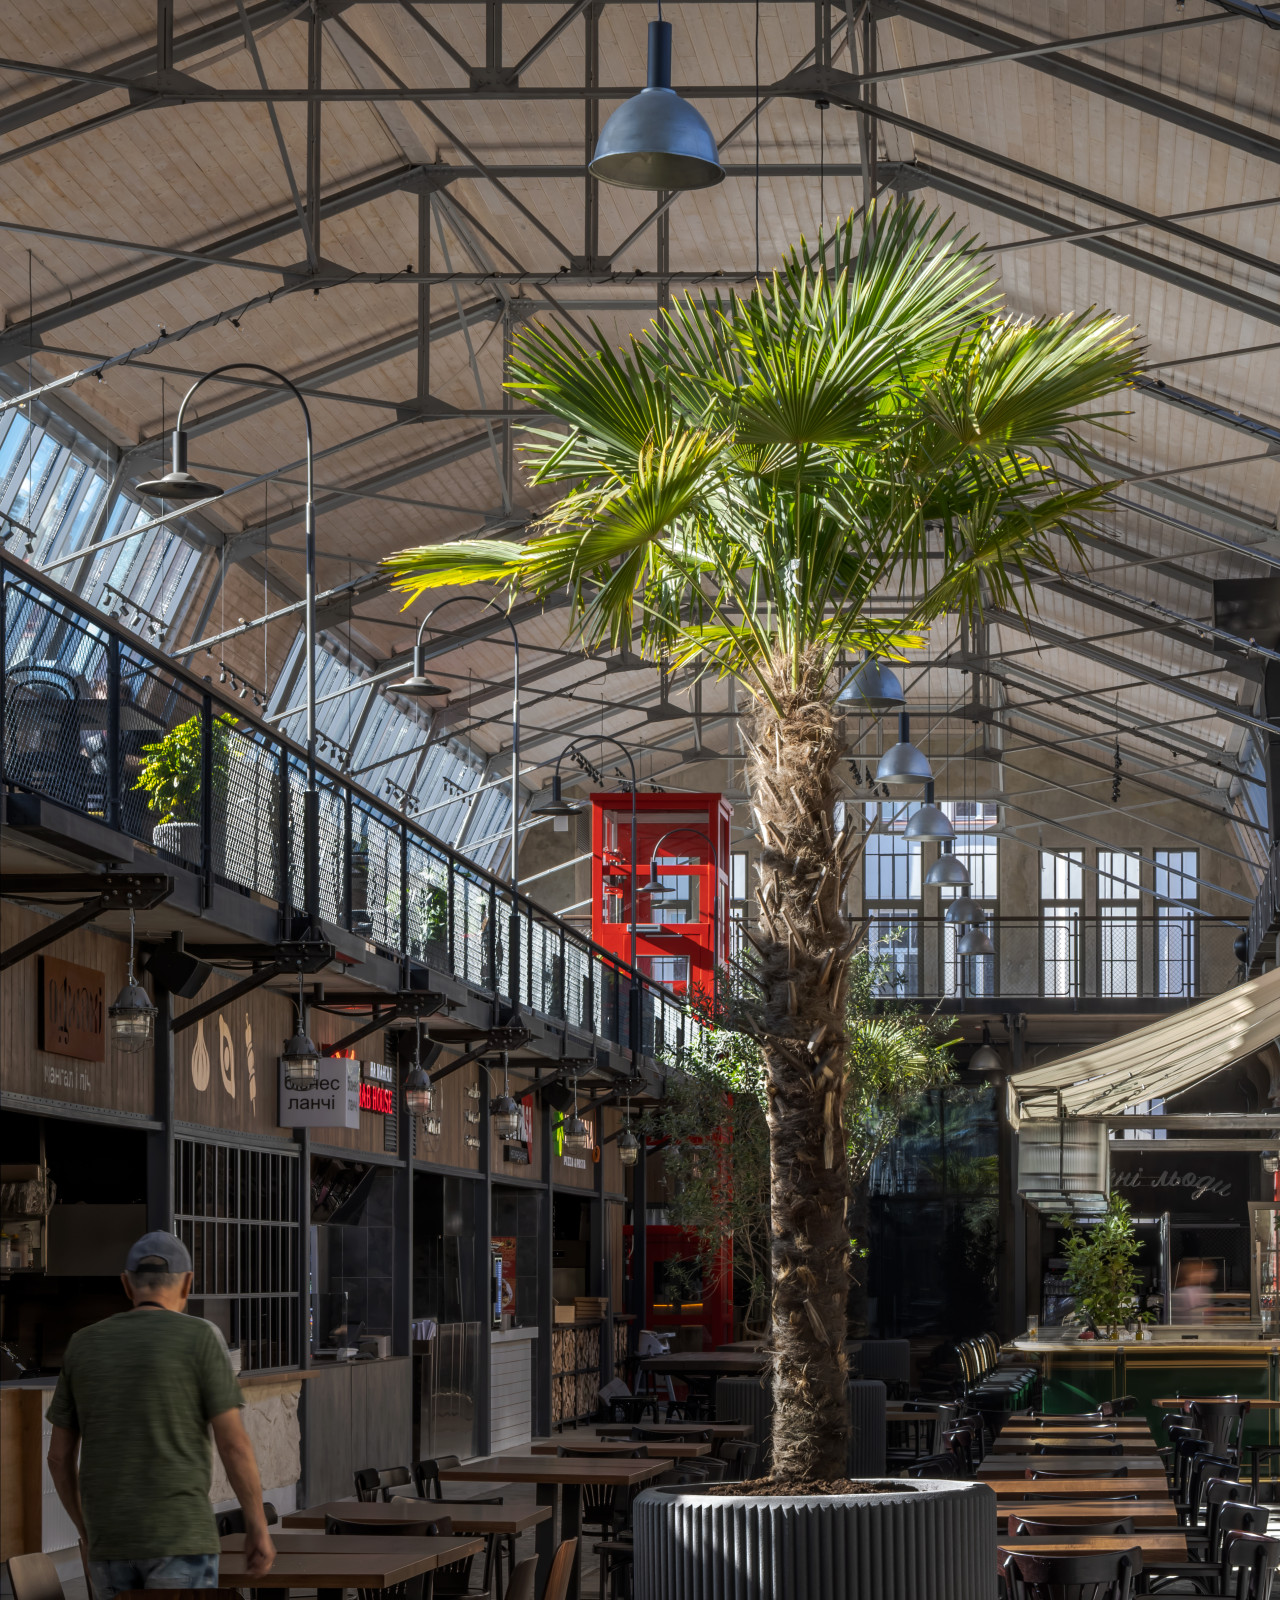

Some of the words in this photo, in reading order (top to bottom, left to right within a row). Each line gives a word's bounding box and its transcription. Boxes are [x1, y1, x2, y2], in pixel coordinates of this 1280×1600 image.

[284, 1075, 340, 1091] бнес
[288, 1095, 335, 1110] ланчі
[372, 1086, 393, 1115] HOUSE
